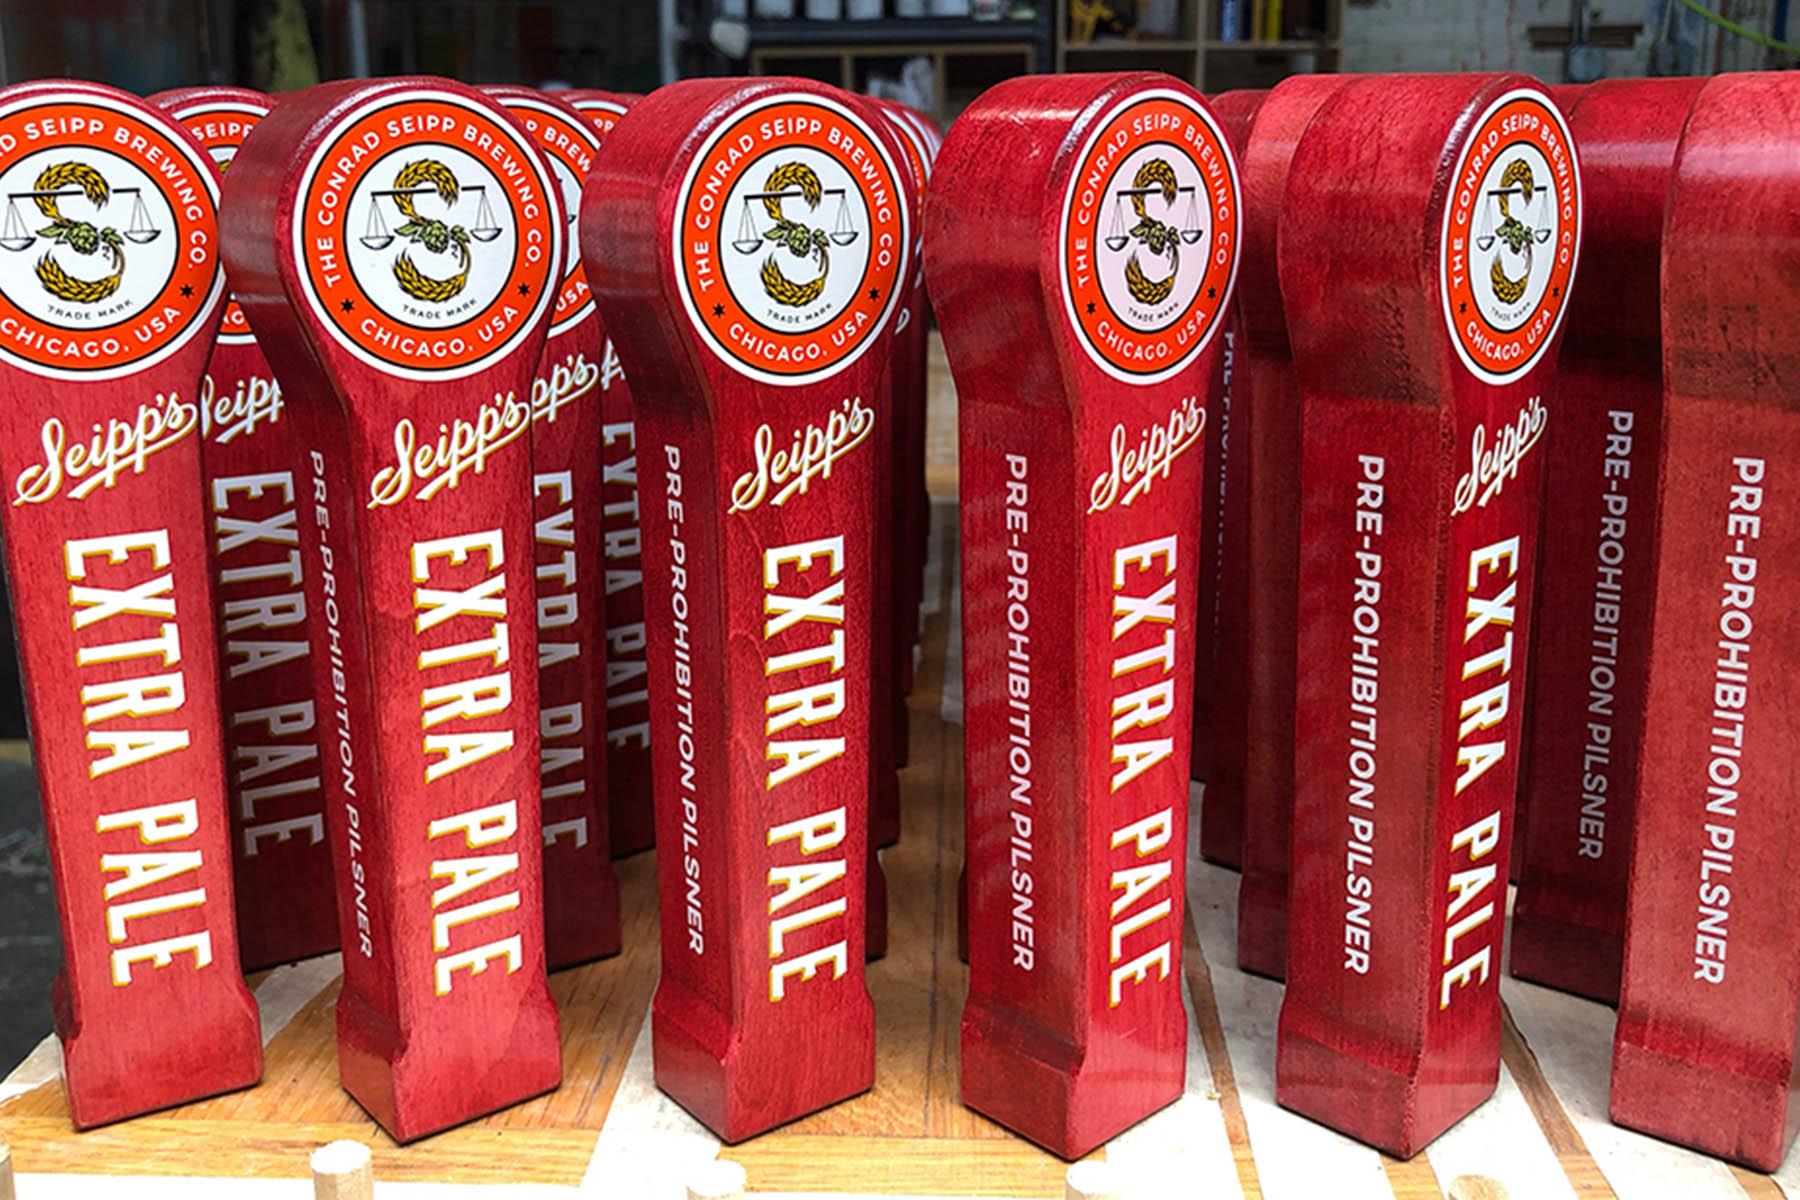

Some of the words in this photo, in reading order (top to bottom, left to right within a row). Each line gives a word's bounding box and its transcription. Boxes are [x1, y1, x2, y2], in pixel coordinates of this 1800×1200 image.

[24, 117, 104, 140] SEIPP
[113, 127, 204, 222] BREWING
[386, 114, 456, 138] SEIPP
[463, 128, 539, 220] BREWING
[544, 128, 592, 173] BREW
[760, 117, 822, 140] SEIPP
[827, 127, 892, 223] BREWING
[1133, 113, 1182, 135] SEIPP
[1184, 126, 1230, 222] BREWING
[1502, 113, 1539, 136] SEIPP
[1540, 124, 1573, 221] BREWING
[317, 131, 380, 225] CONRAD
[695, 134, 754, 229] CONRAD
[1078, 132, 1129, 225] CONRAD
[1456, 131, 1499, 225] CONRAD
[47, 305, 92, 321] TRADE
[98, 300, 133, 318] MARK
[316, 237, 342, 288] THE
[403, 304, 441, 319] TRADE
[446, 298, 478, 317] MARK
[554, 282, 588, 312] USA
[694, 241, 715, 292] THE
[767, 308, 801, 324] TRADE
[805, 303, 832, 321] MARK
[1076, 237, 1088, 289] THE
[1128, 307, 1154, 322] TRADE
[1453, 237, 1463, 289] THE
[134, 306, 182, 343] USA
[478, 304, 519, 342] USA
[831, 310, 868, 346] USA
[1176, 310, 1206, 345] USA
[1527, 309, 1551, 344] USA
[12, 391, 199, 507] Seipp's
[367, 391, 532, 510] Seipp's
[727, 396, 875, 514] Seipp's
[1087, 396, 1207, 515] Seipp's
[1451, 395, 1548, 516] Seipp's
[211, 471, 310, 679] EXTRA
[1588, 410, 1634, 716] PRE-PROHIBITION
[63, 528, 191, 779] EXTRA
[410, 528, 515, 784] EXTRA
[763, 534, 846, 791] EXTRA
[1005, 453, 1031, 805] PRE-PROHIBITION
[1111, 534, 1178, 795] EXTRA
[1348, 454, 1385, 809] PRE-PROHIBITION
[1454, 535, 1520, 796] EXTRA
[1705, 456, 1765, 816] PRE-PROHIBITION
[310, 450, 357, 797] PRE-PROHIBITION
[346, 803, 372, 958] PILSNER
[664, 444, 696, 791] PRE-PROHIBITION
[682, 797, 704, 955] PILSNER
[233, 699, 324, 857] PALE
[1578, 722, 1611, 859] PILSNER
[96, 798, 213, 987] PALE
[427, 799, 523, 997] PALE
[767, 806, 847, 1003] PALE
[1010, 811, 1034, 972] PILSNER
[1109, 807, 1172, 1009] PALE
[1344, 815, 1374, 975] PILSNER
[1439, 810, 1501, 1011] PALE
[1693, 823, 1735, 985] PILSNER
